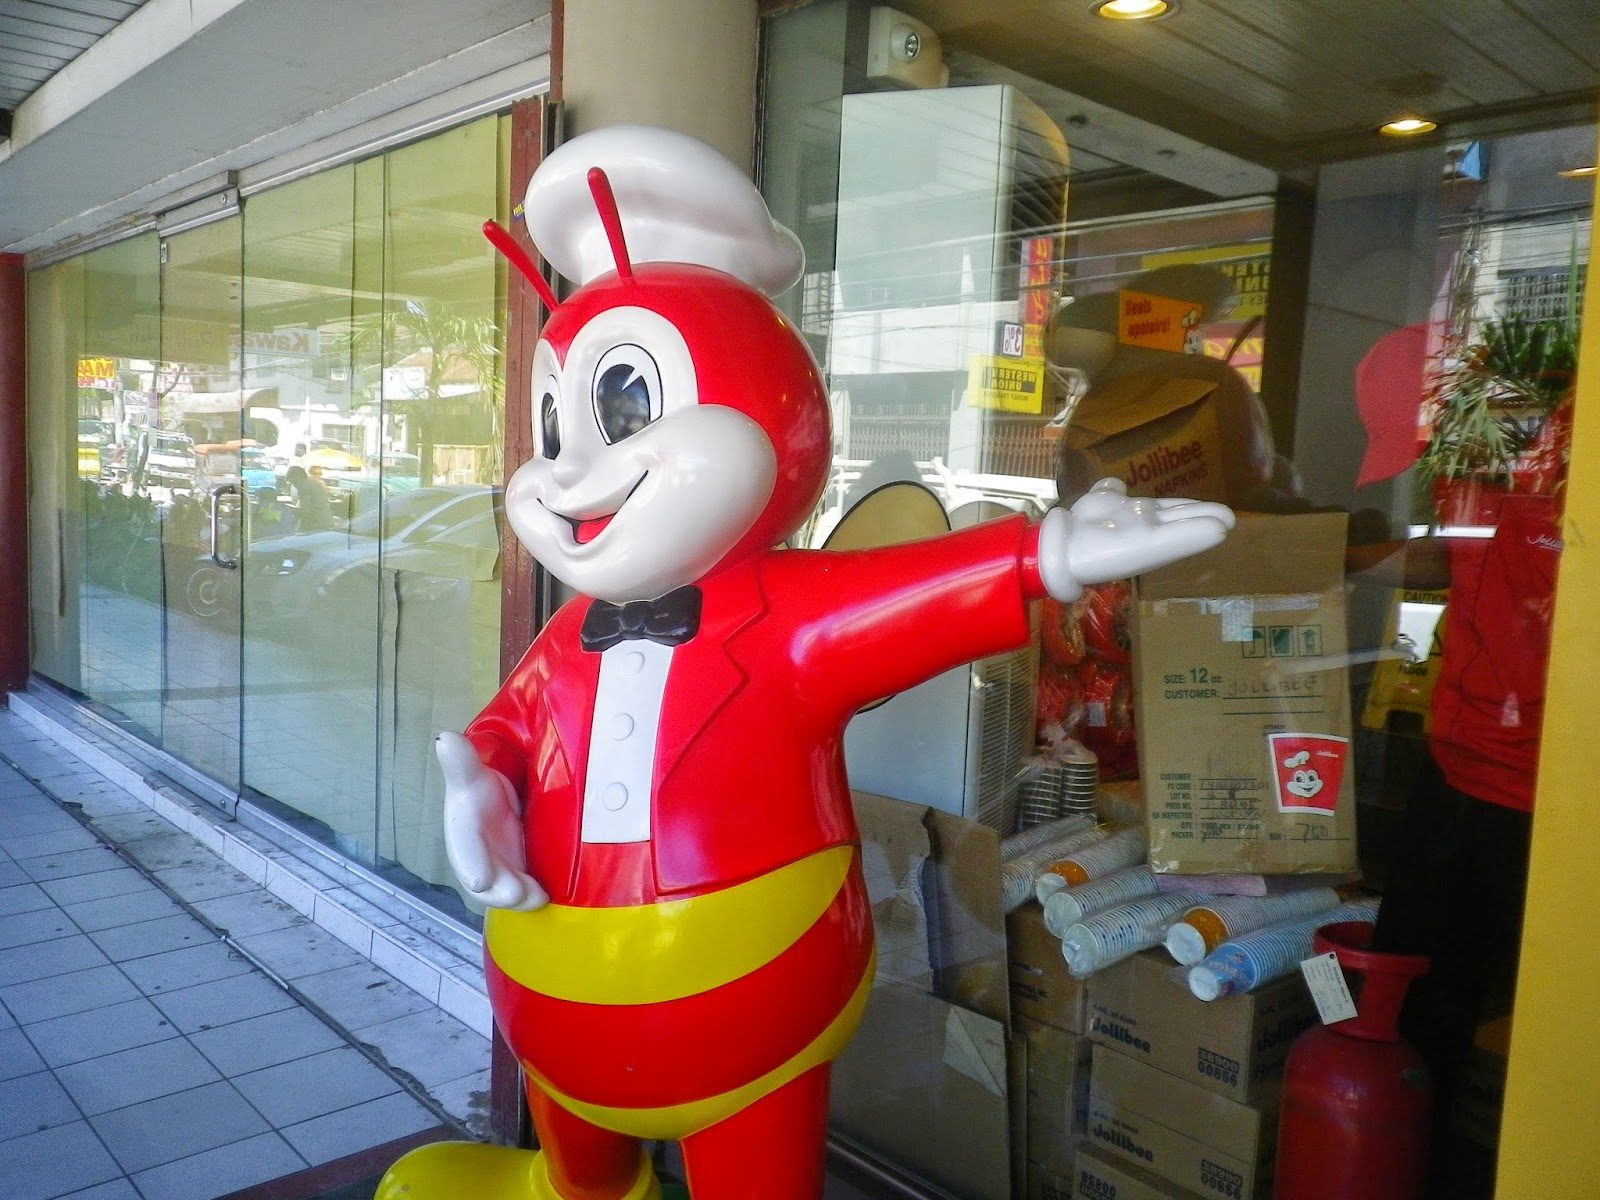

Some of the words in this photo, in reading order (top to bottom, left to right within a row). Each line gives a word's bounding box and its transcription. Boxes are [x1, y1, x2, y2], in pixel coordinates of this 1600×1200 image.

[1126, 440, 1202, 489] Jollibee
[1190, 668, 1209, 684] 12
[1165, 689, 1220, 700] CUSTOMER:
[1092, 1017, 1151, 1053] Jollibee
[1093, 1123, 1154, 1162] Jollibee
